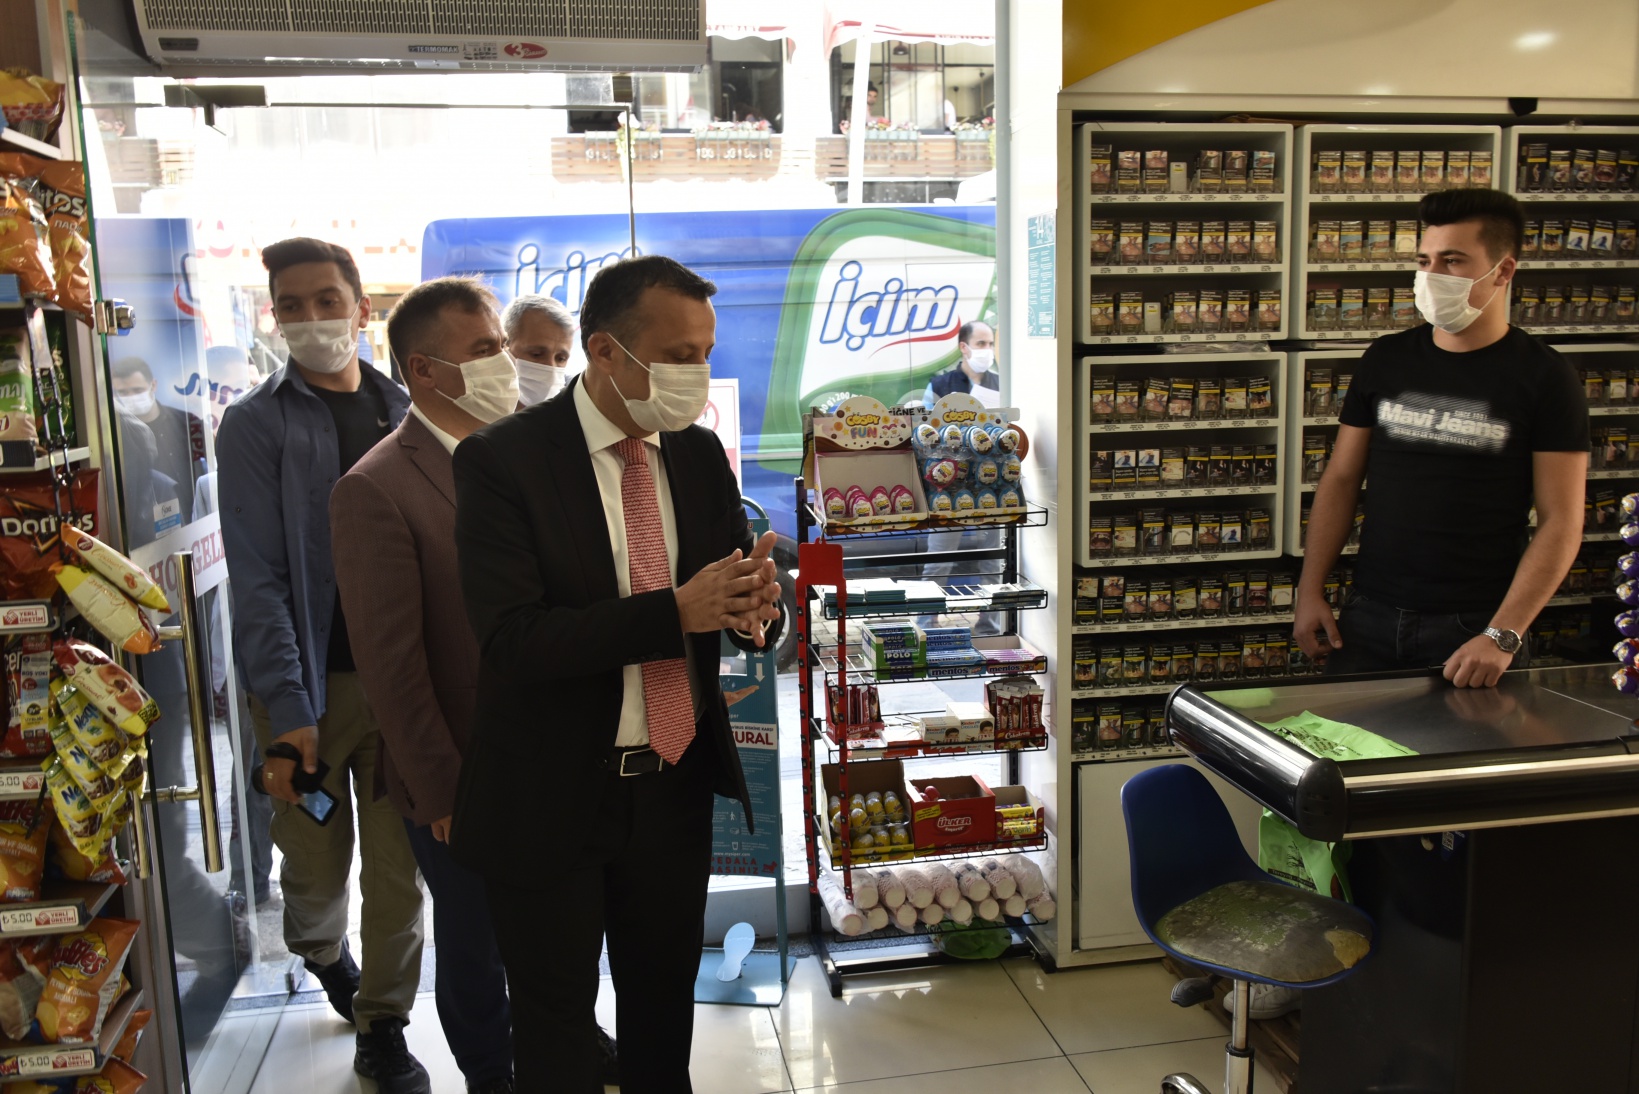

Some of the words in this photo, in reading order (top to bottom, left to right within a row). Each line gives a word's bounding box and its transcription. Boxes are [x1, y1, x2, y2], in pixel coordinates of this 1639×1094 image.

[819, 260, 959, 352] İçim
[846, 413, 881, 427] COSBY
[942, 409, 977, 423] COSBY
[1378, 401, 1436, 427] Mavi
[1435, 411, 1506, 440] Jeans
[850, 426, 878, 440] FUN
[1, 513, 94, 536] Doris
[931, 667, 969, 676] mentos
[989, 664, 1020, 672] mentos
[937, 816, 972, 828] ÜLKER
